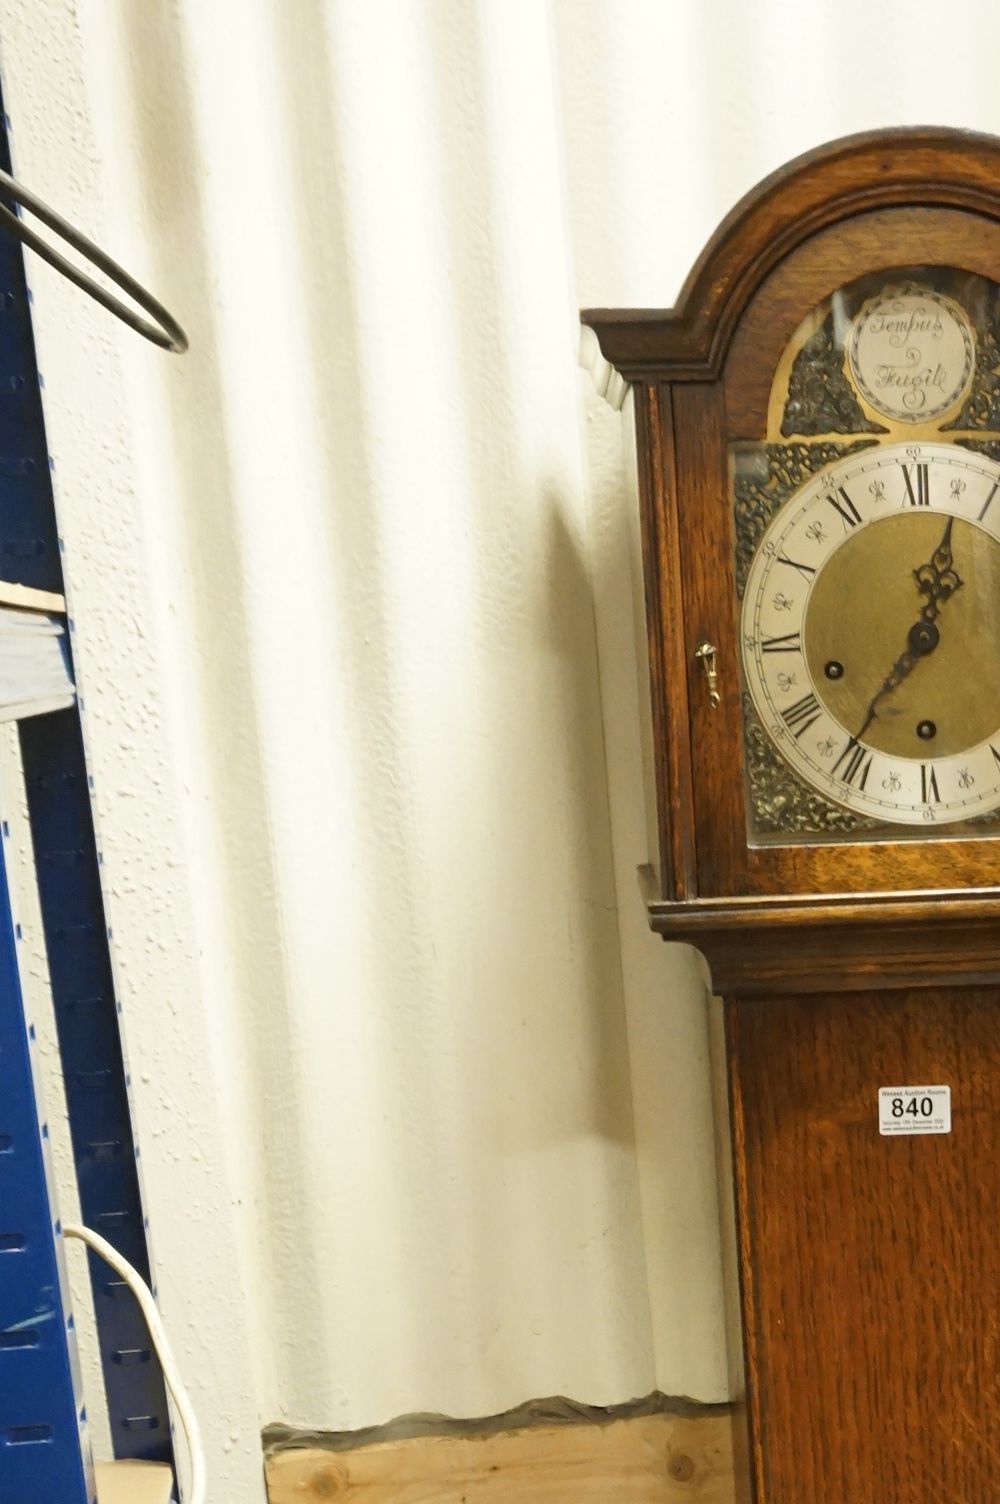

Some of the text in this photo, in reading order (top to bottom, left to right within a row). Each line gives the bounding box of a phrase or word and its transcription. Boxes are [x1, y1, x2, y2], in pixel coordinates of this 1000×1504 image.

[870, 301, 943, 348] Tempus
[874, 348, 947, 410] Fugit
[906, 447, 921, 457] 60
[901, 463, 930, 508] XII
[826, 486, 862, 534] XI
[777, 550, 816, 584] X
[760, 631, 801, 657] IX
[781, 692, 823, 740] VIII
[920, 764, 940, 803] VI
[892, 1097, 933, 1118] 840
